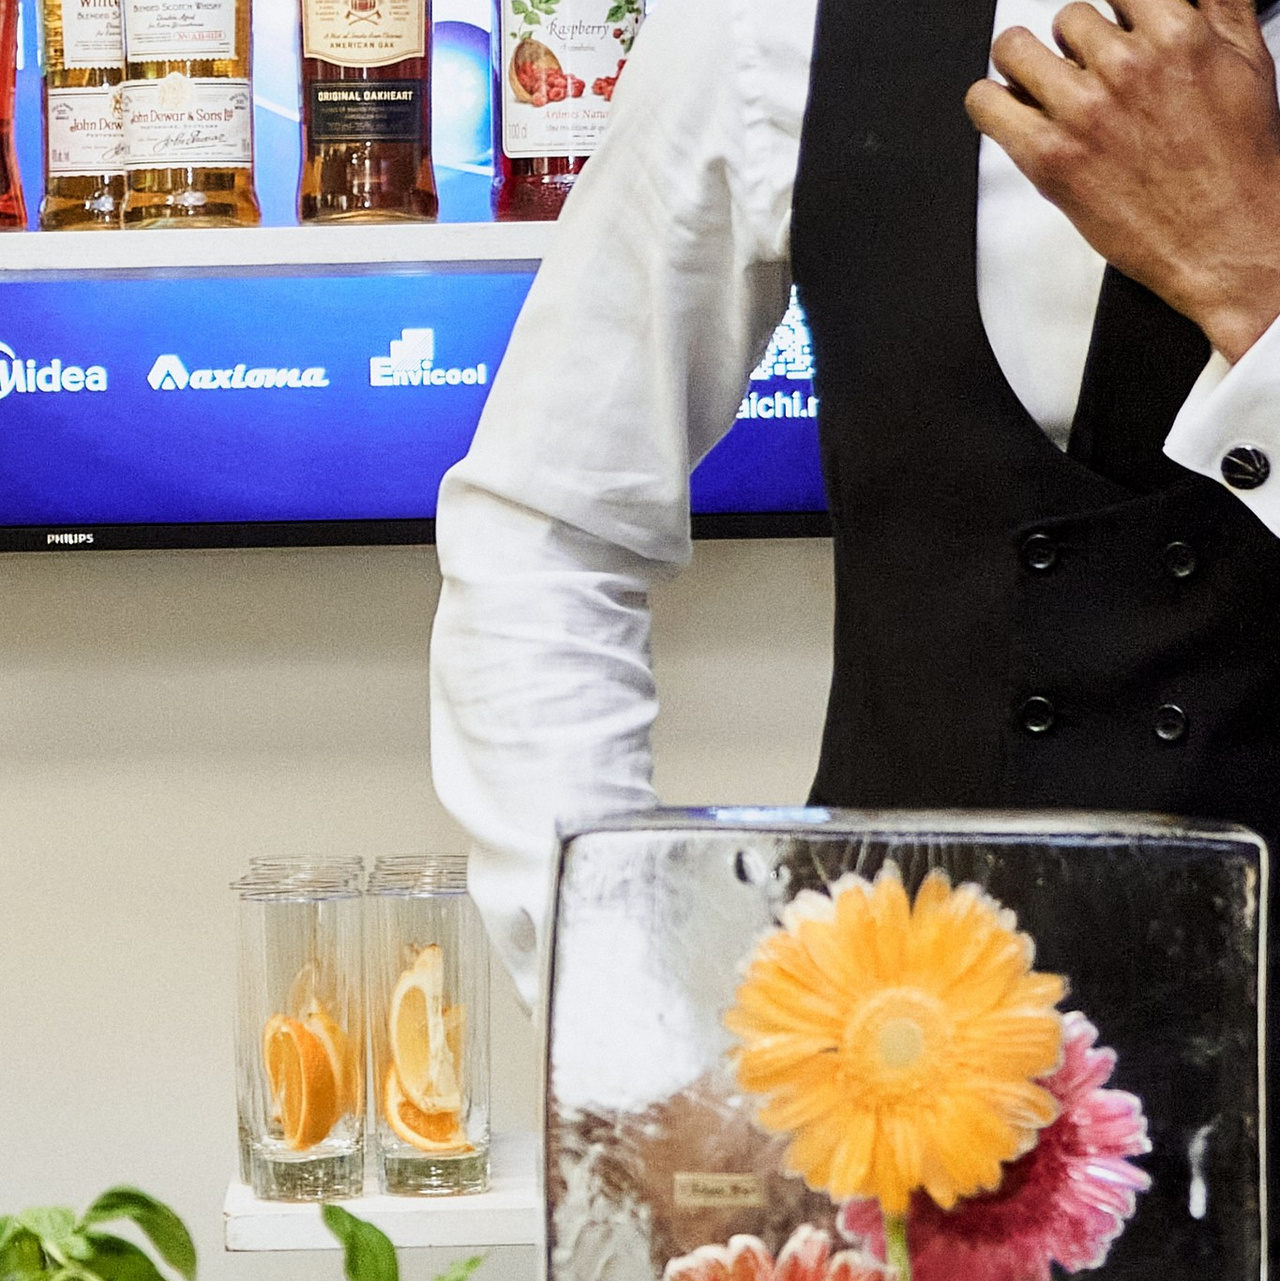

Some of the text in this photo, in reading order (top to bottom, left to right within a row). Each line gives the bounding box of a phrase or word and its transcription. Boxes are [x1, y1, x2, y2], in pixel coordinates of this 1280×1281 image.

[546, 18, 610, 40] Raspberry
[330, 41, 395, 49] AMERICAN OAK
[317, 90, 414, 102] ORIGINAL OAKHEART
[150, 109, 184, 122] Dewar
[196, 108, 222, 122] Sons
[70, 118, 97, 133] John
[0, 358, 107, 393] Midea
[369, 357, 488, 387] Envicool
[46, 532, 95, 545] PHILIPS
